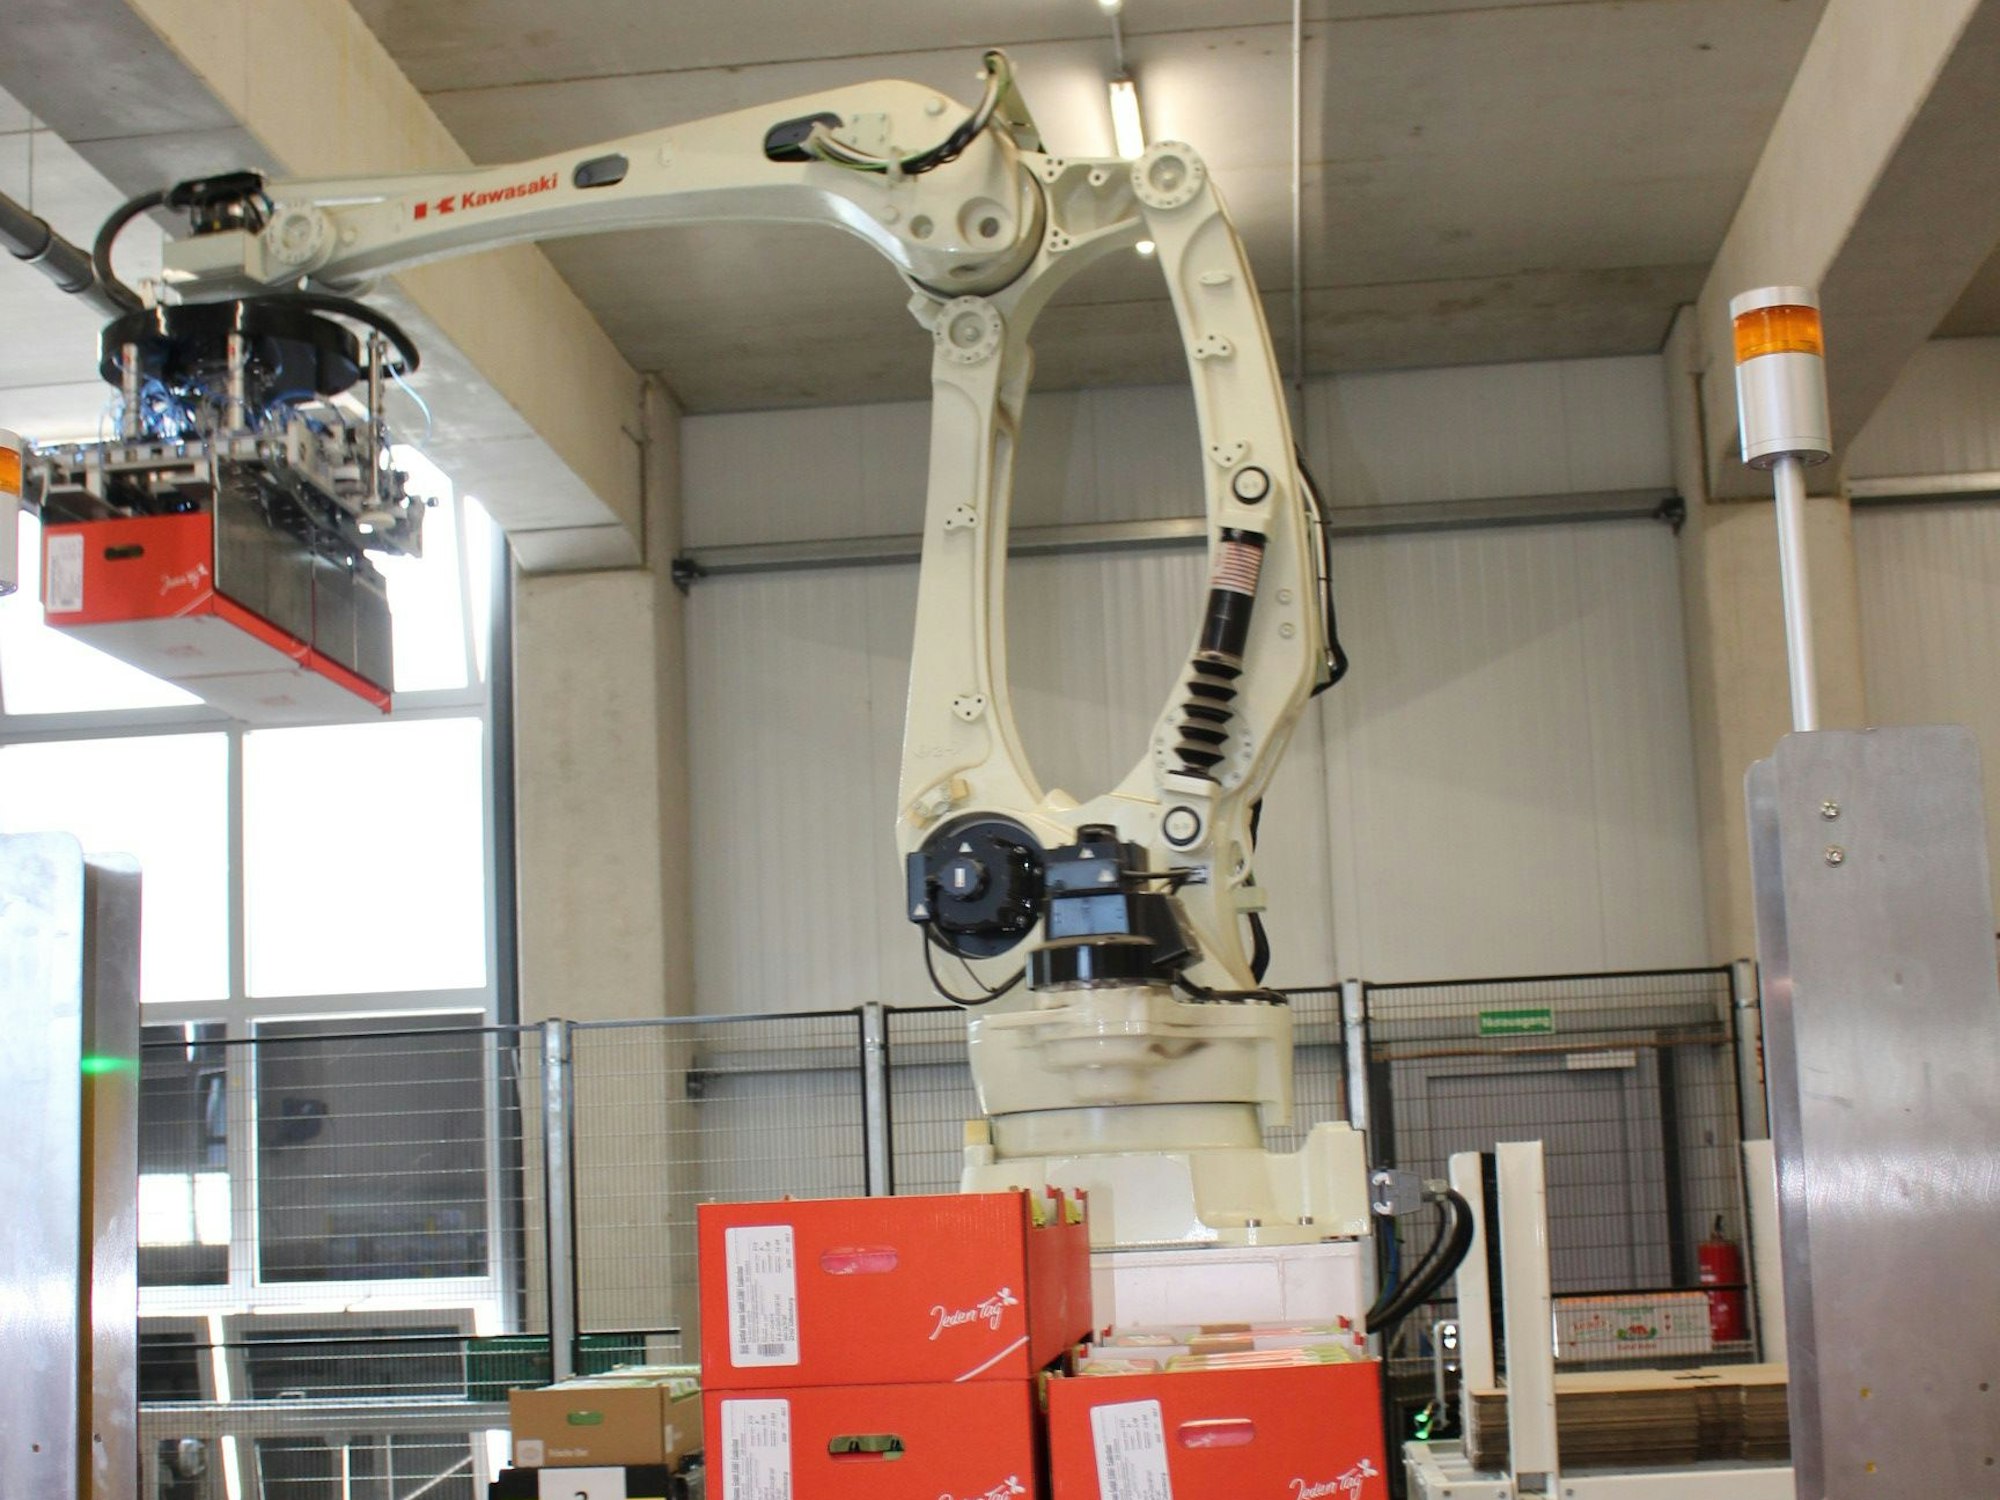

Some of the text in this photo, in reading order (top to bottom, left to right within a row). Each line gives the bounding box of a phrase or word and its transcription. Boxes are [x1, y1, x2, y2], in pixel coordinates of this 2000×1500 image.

[461, 172, 558, 209] Kawasaki
[929, 1296, 1003, 1341] Jeden Tag
